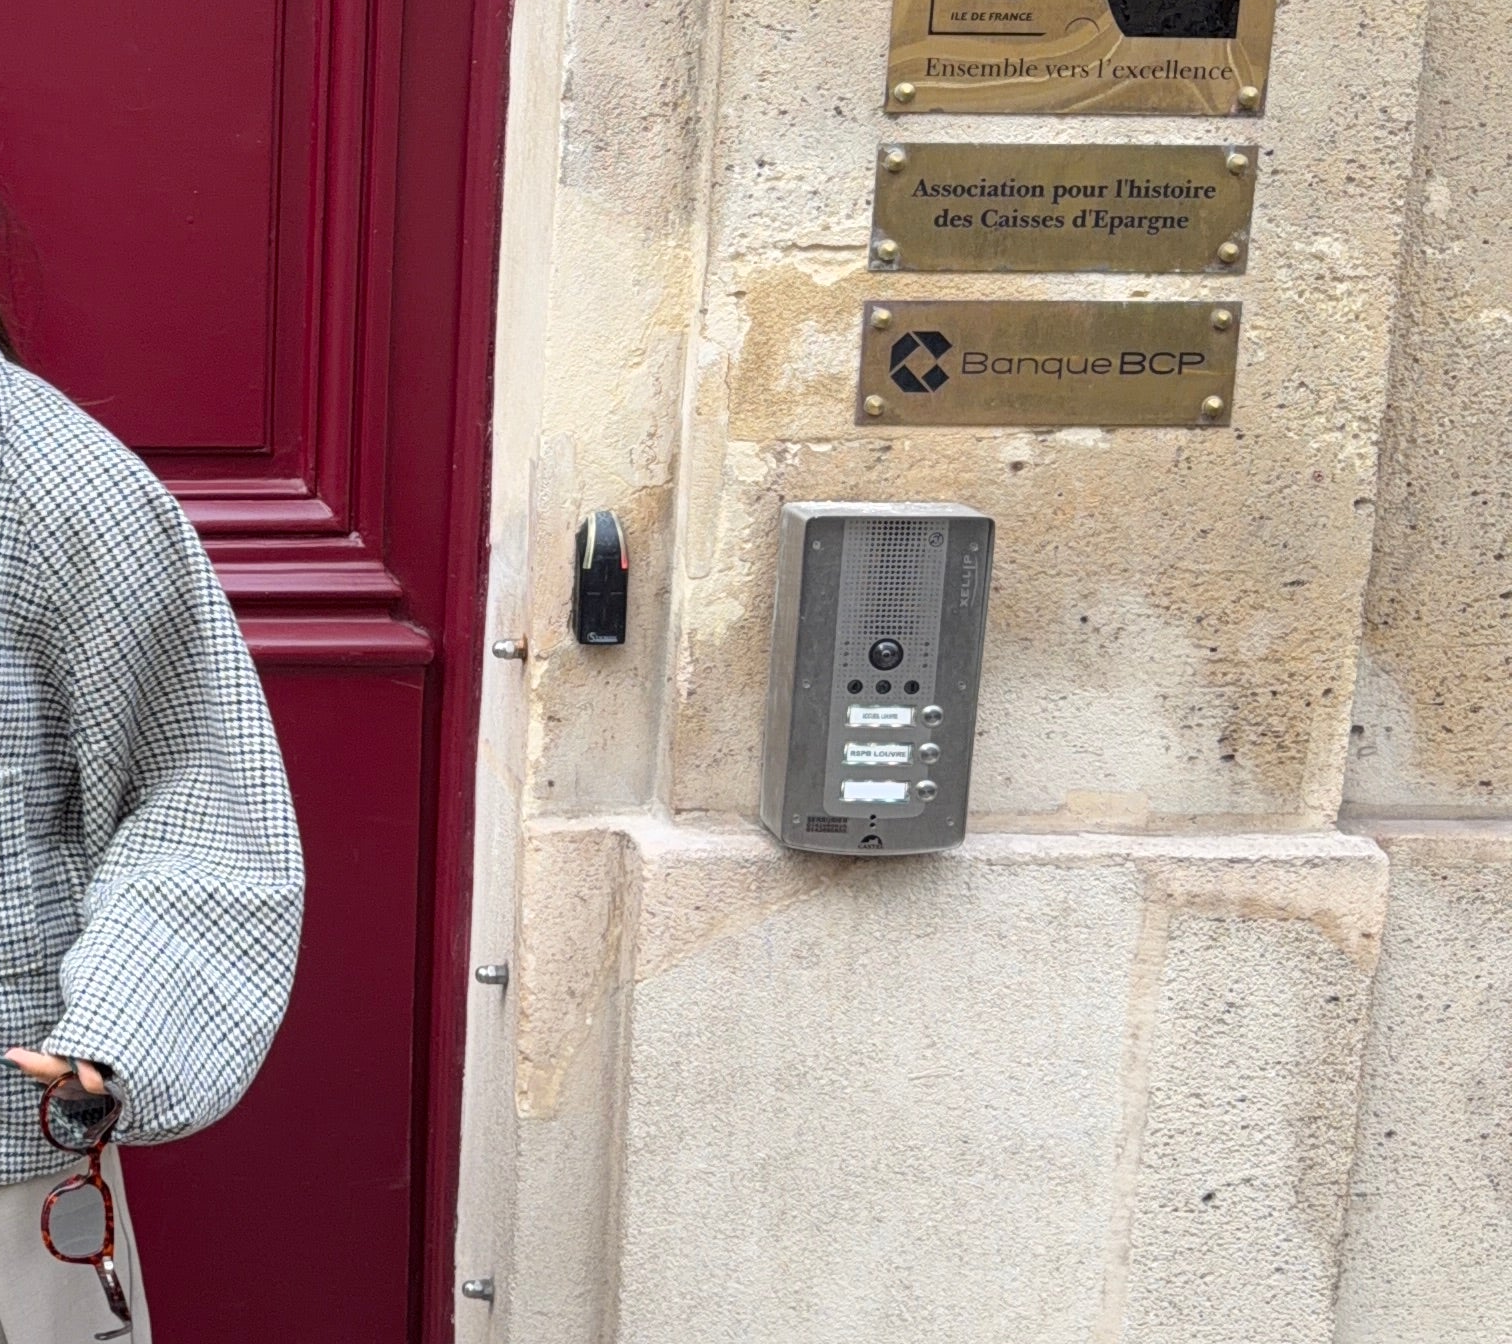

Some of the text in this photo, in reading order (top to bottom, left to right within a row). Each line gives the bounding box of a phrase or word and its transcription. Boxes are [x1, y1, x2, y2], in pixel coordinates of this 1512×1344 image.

[950, 11, 1033, 22] ILE DE FRANCE
[924, 57, 1234, 81] Ensemble vers l'excellence
[912, 178, 1217, 204] Association pour l'histoire
[933, 209, 1189, 234] des Caisses d'Epargne
